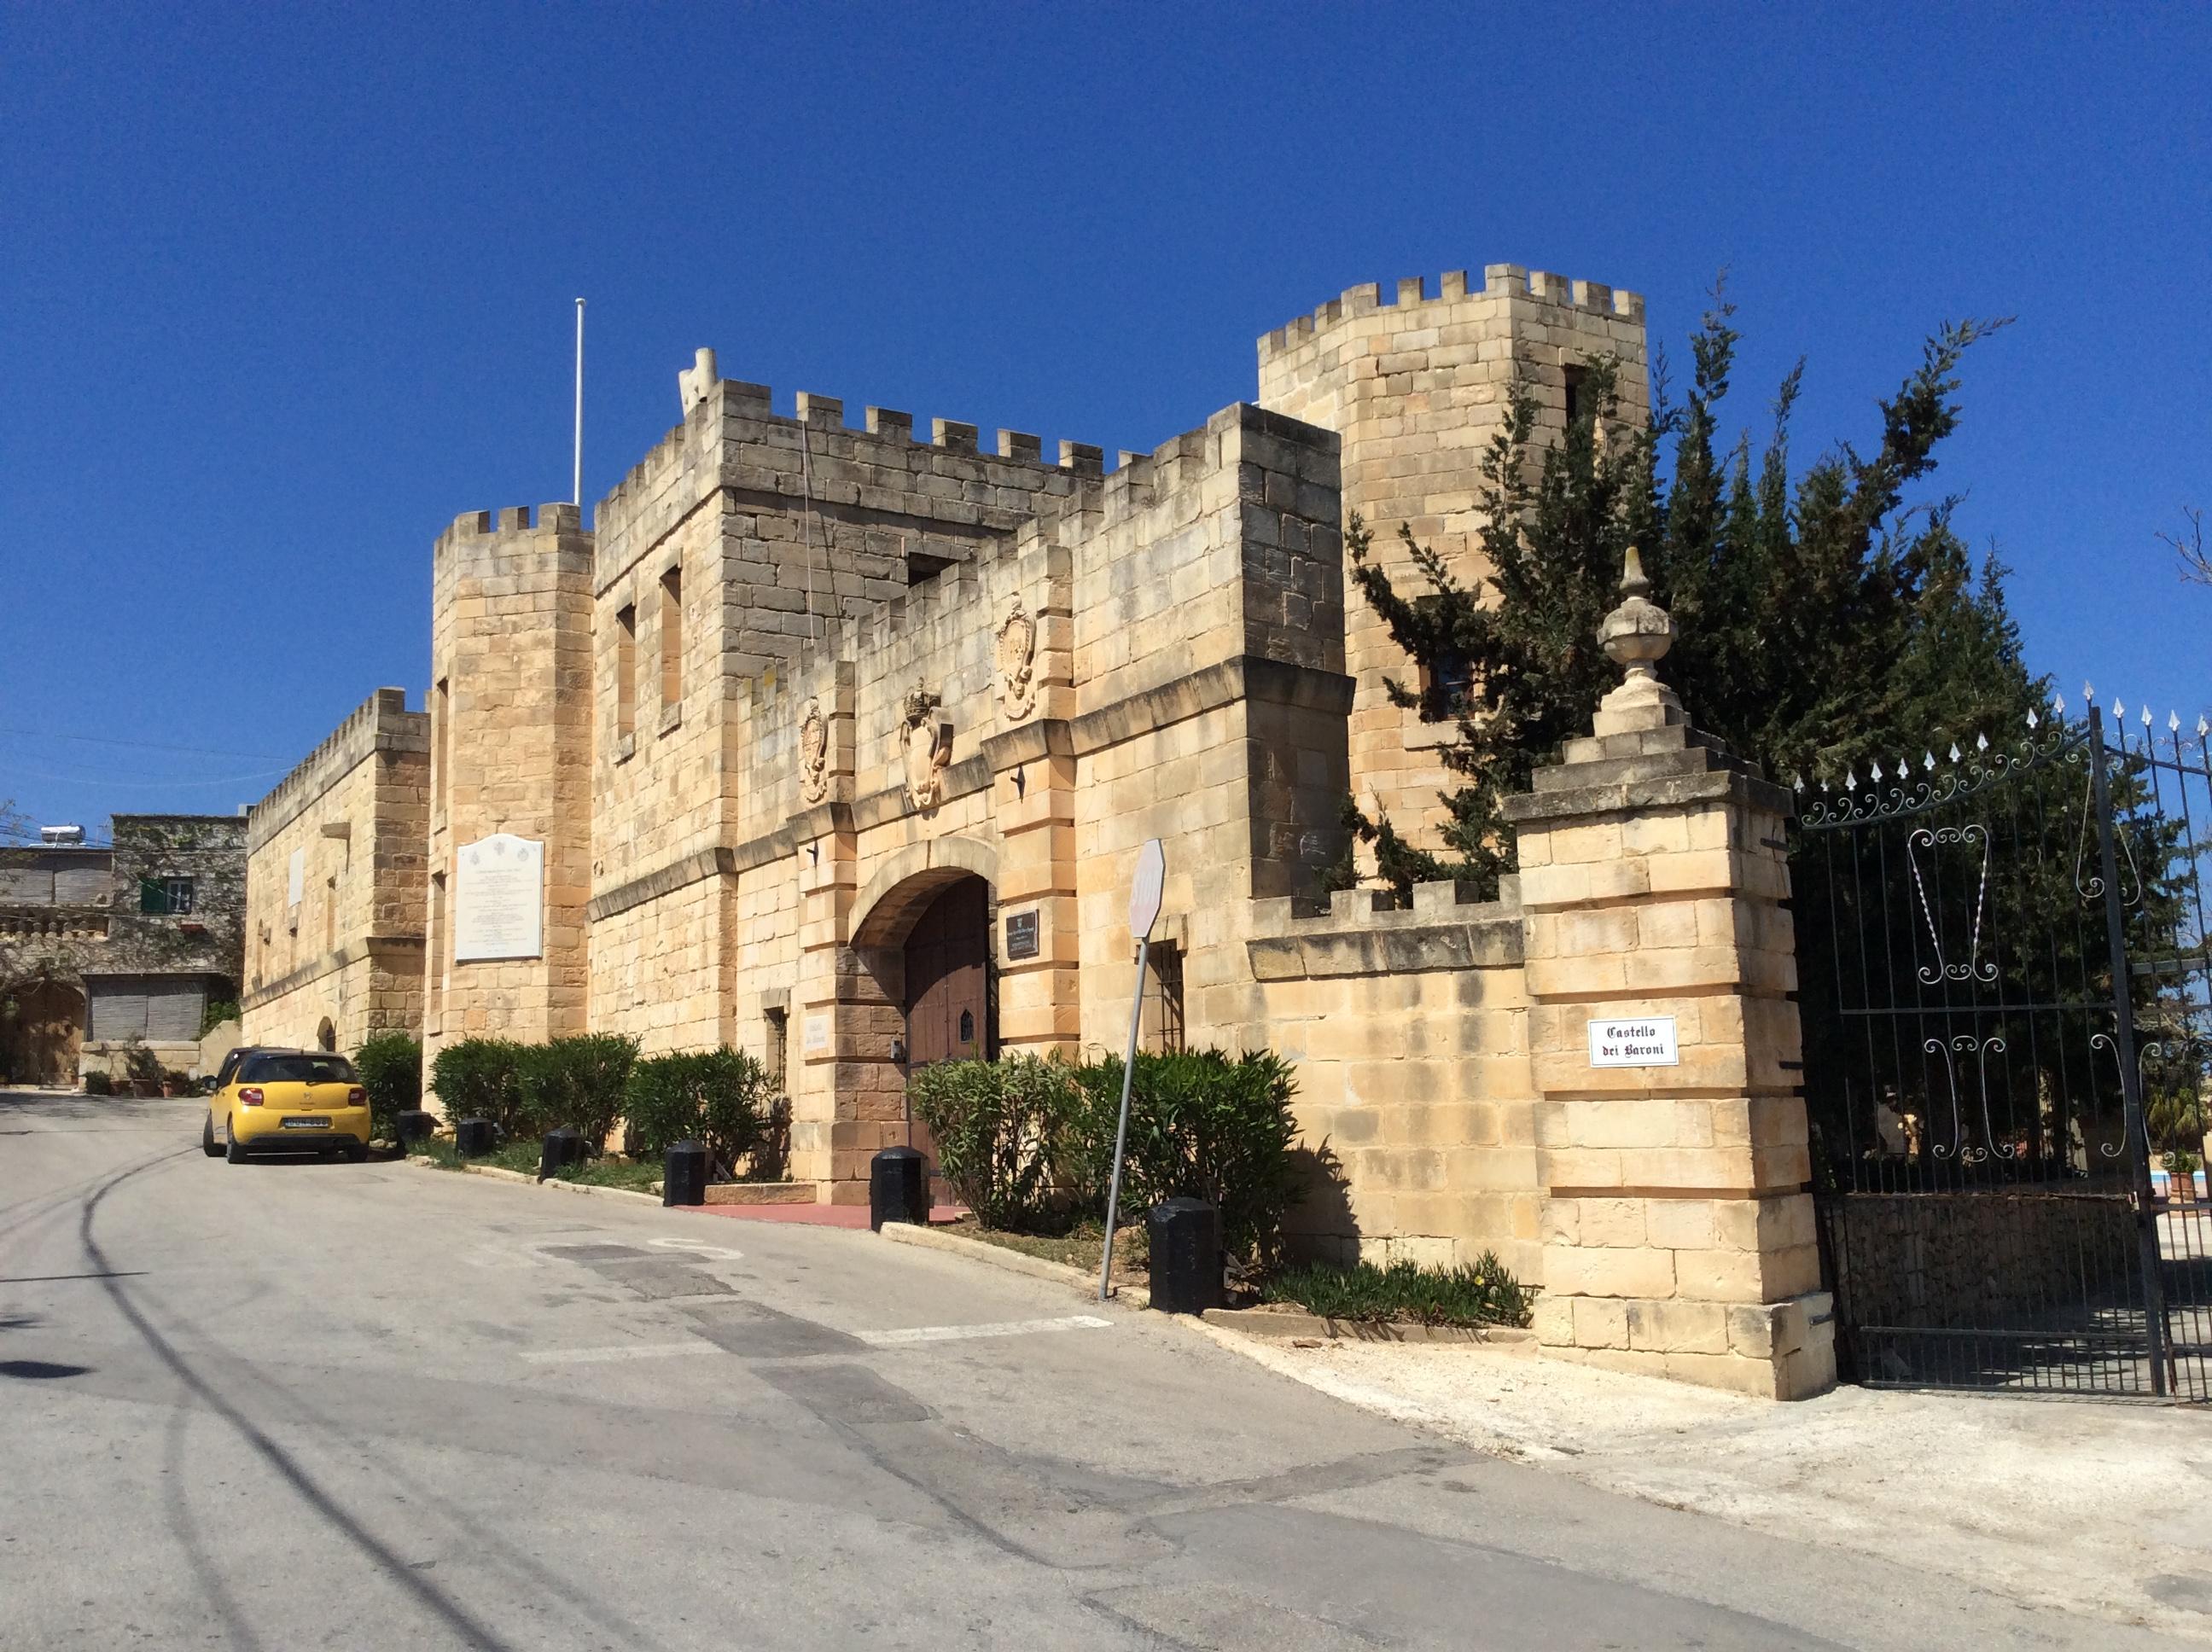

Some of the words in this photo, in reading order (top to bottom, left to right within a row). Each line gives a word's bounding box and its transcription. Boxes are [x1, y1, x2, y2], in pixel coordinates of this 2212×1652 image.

[1607, 1026, 1656, 1038] Castello
[1602, 1044, 1619, 1056] dei
[1624, 1043, 1664, 1058] Baroni
